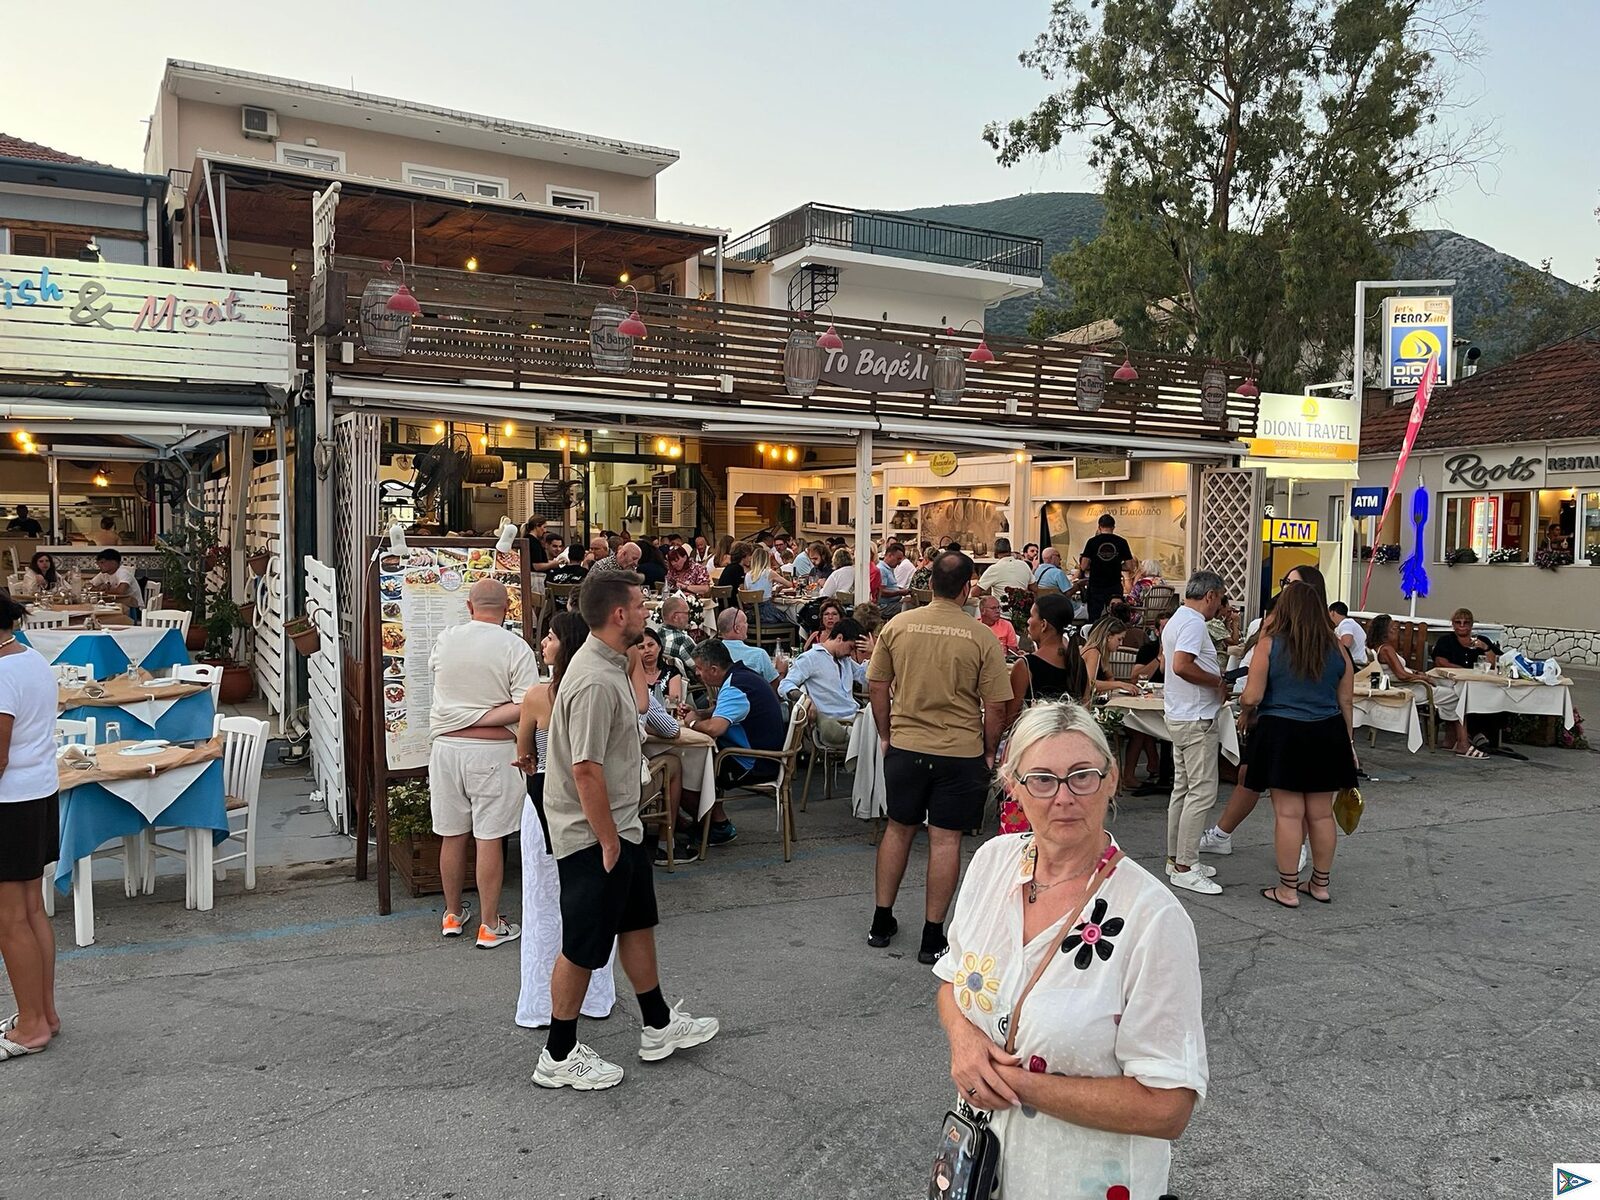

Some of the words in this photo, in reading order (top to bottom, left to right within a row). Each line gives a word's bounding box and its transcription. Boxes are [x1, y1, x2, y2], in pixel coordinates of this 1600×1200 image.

[0, 266, 63, 309] ish
[70, 281, 115, 330] &
[132, 290, 243, 332] Meat
[361, 307, 410, 324] Taverna
[1394, 313, 1432, 323] FERRY
[855, 349, 929, 383] Βαρέλι
[1393, 366, 1442, 376] DIOI
[1263, 419, 1301, 437] DIONI
[1306, 423, 1352, 440] TRAVEL
[1444, 453, 1542, 489] Roots
[1355, 495, 1378, 508] ATM
[1279, 522, 1311, 540] ATM
